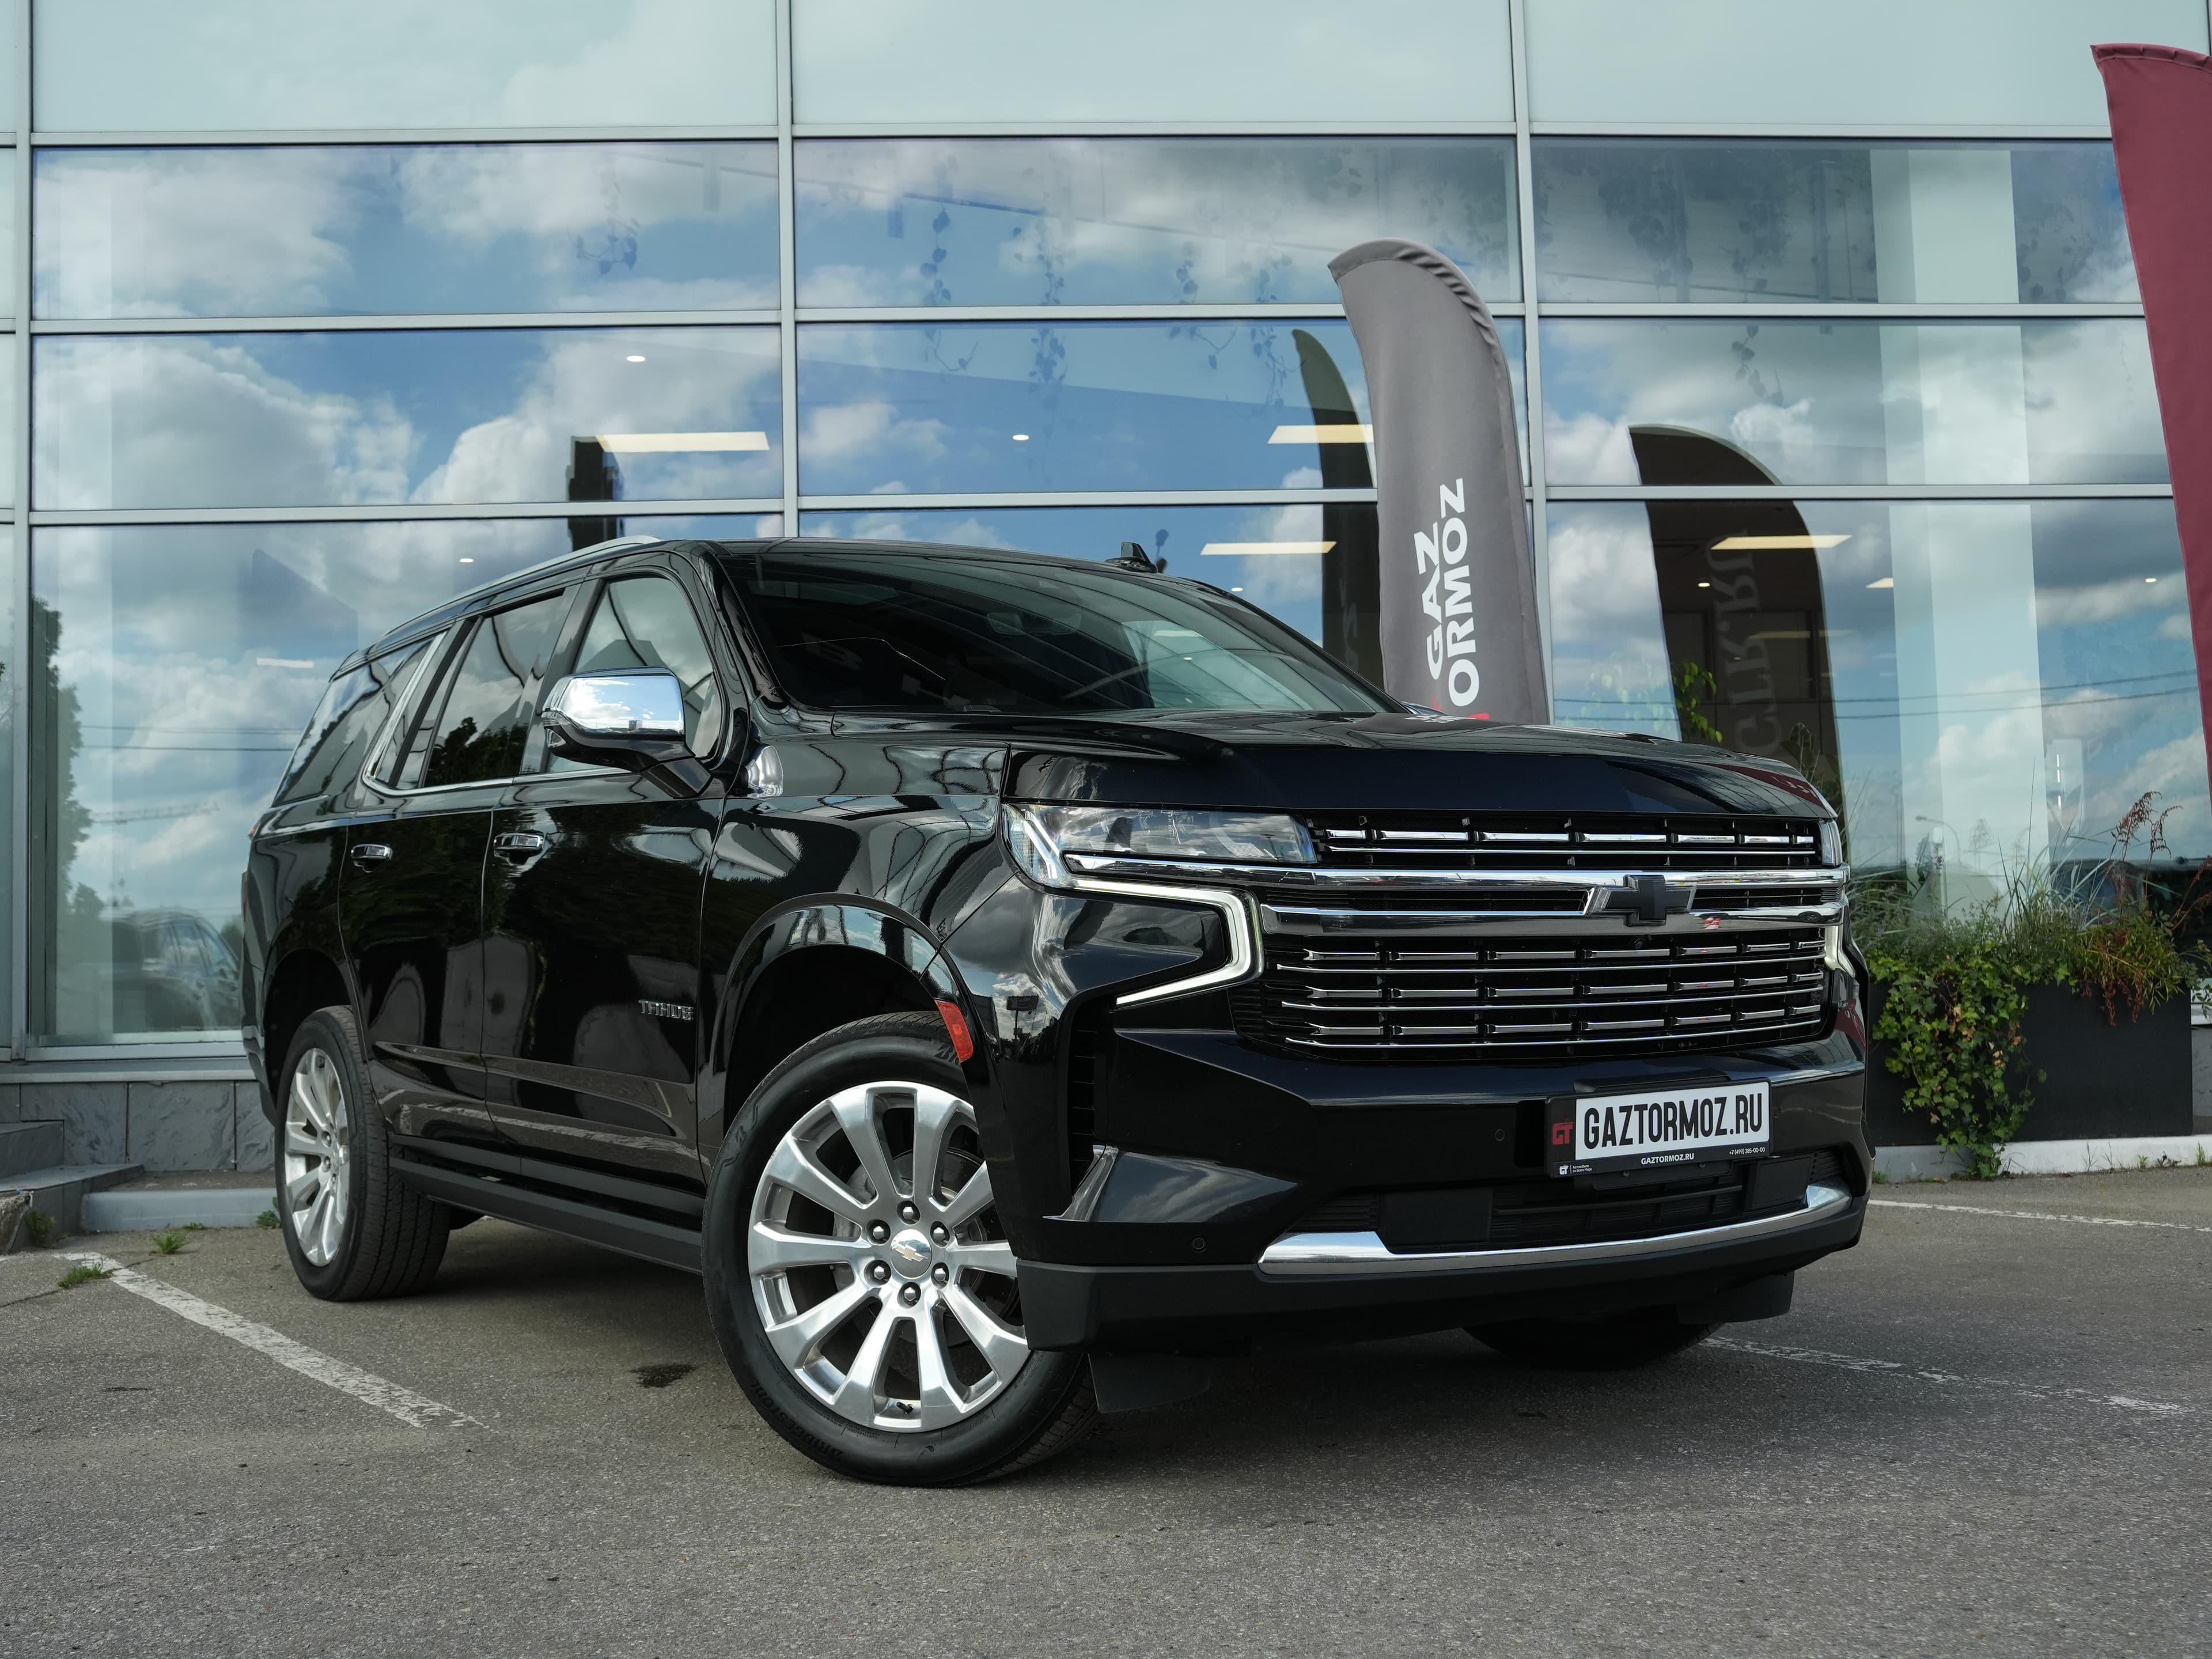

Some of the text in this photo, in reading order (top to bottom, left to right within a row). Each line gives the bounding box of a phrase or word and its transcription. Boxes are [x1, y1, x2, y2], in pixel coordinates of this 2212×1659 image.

[1414, 522, 1443, 680] GAZ
[638, 999, 694, 1021] TAHOE
[1584, 1093, 1762, 1149] GAZTORMOZ.RU
[1641, 1153, 1694, 1165] GAZTORMOZ.RU
